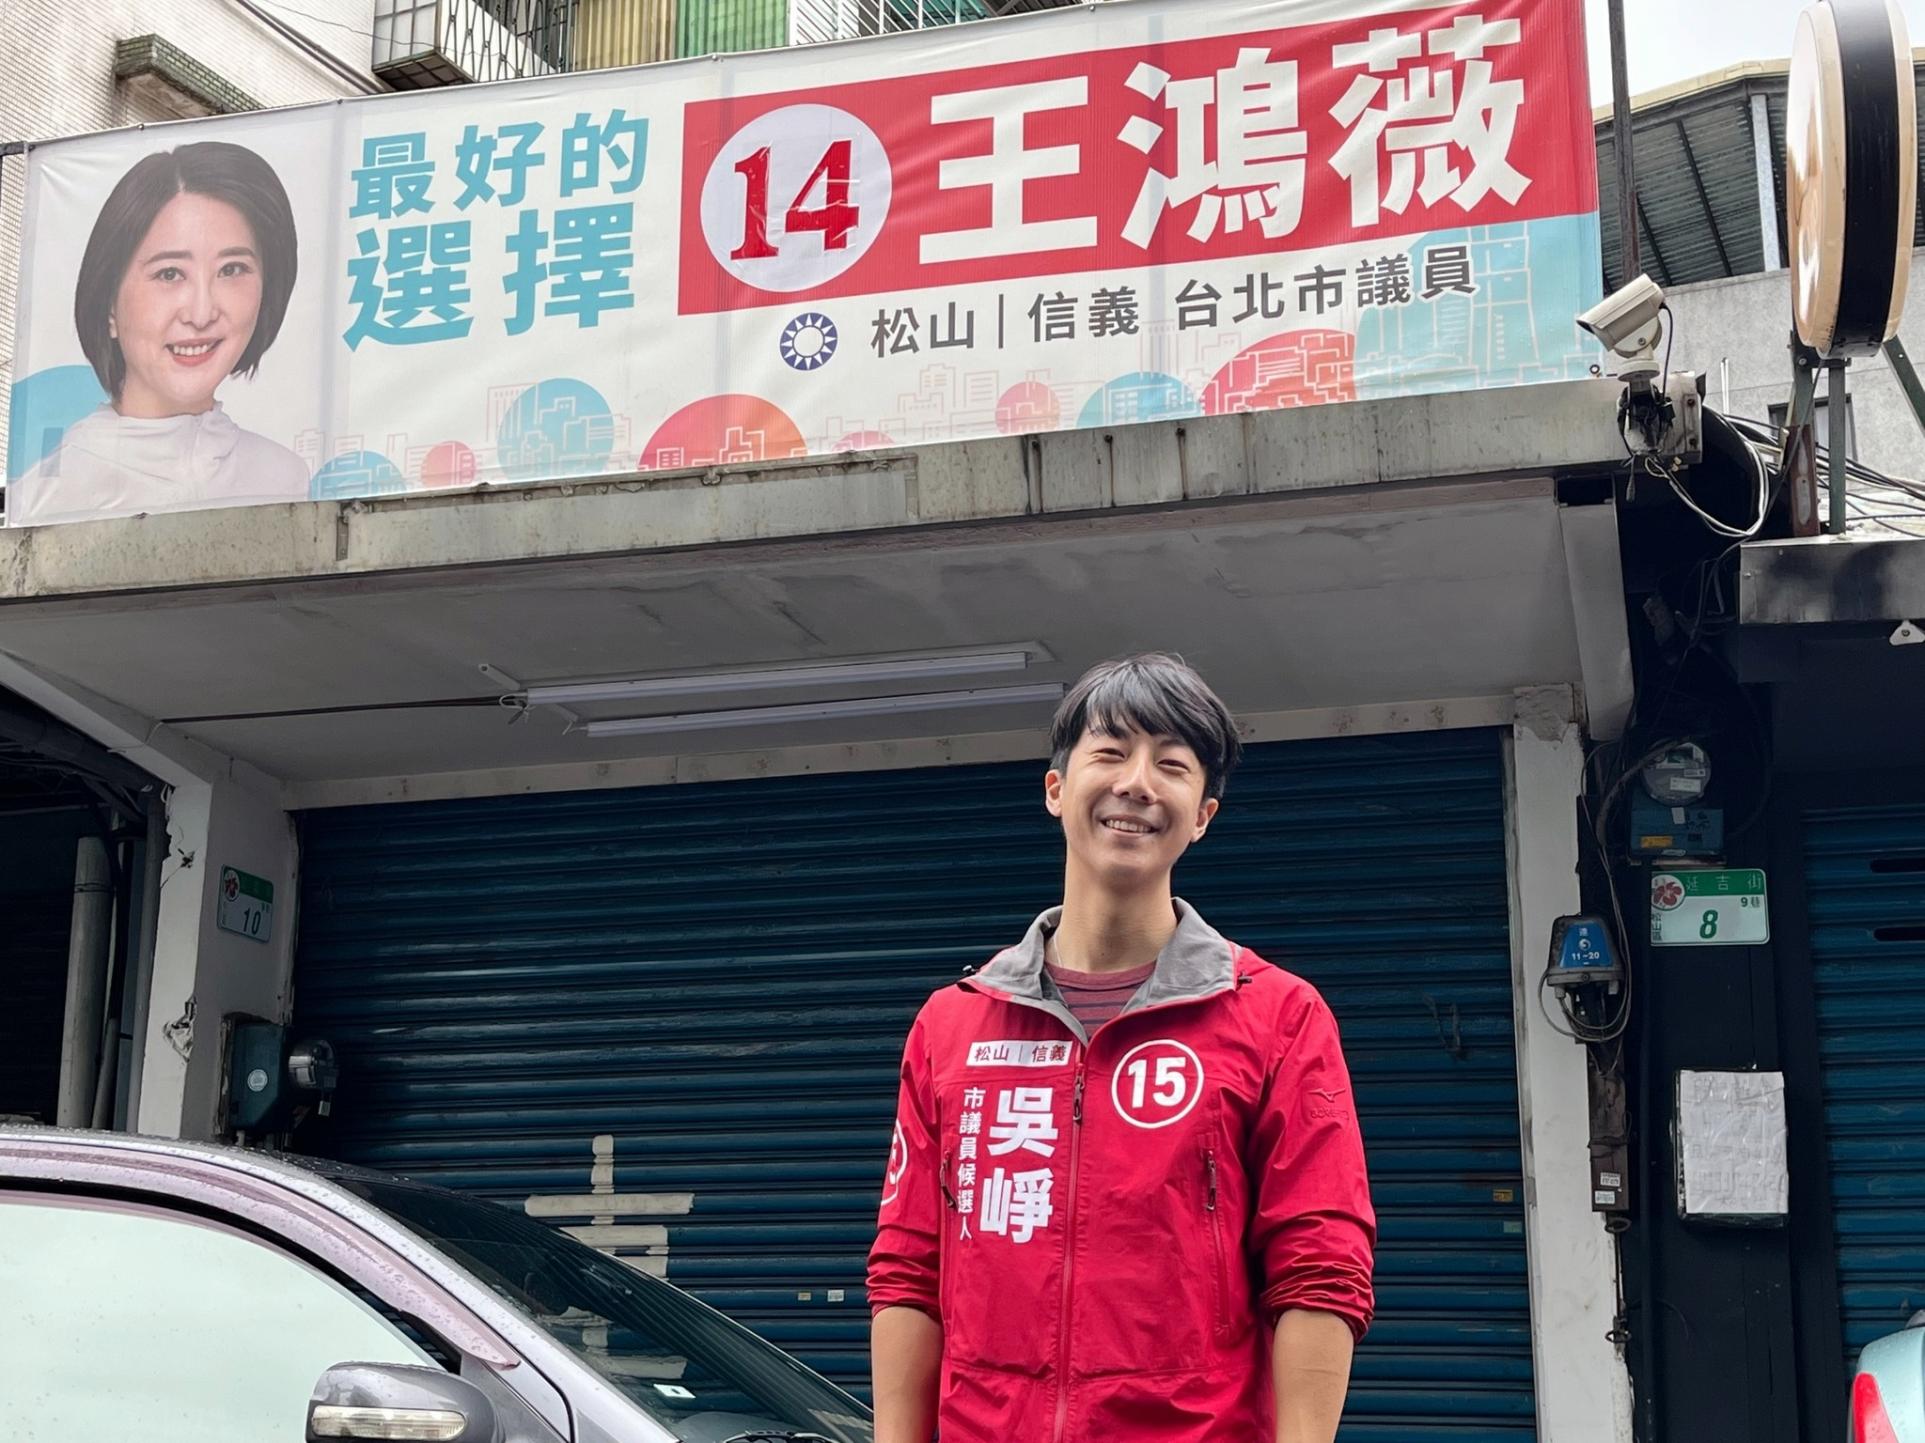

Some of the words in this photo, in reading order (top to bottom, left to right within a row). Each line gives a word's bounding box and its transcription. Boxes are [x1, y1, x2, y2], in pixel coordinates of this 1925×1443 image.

[348, 109, 649, 221] 最好的
[920, 16, 1532, 264] 王鴻薇
[729, 140, 861, 262] 14
[342, 202, 635, 353] 選擇
[1174, 244, 1477, 330] 台北市議員
[244, 907, 261, 934] 10
[1699, 908, 1719, 939] 8
[1127, 1056, 1187, 1109] 15
[957, 1086, 986, 1241] 市議員候選人
[979, 1086, 1059, 1244] 吳崢
